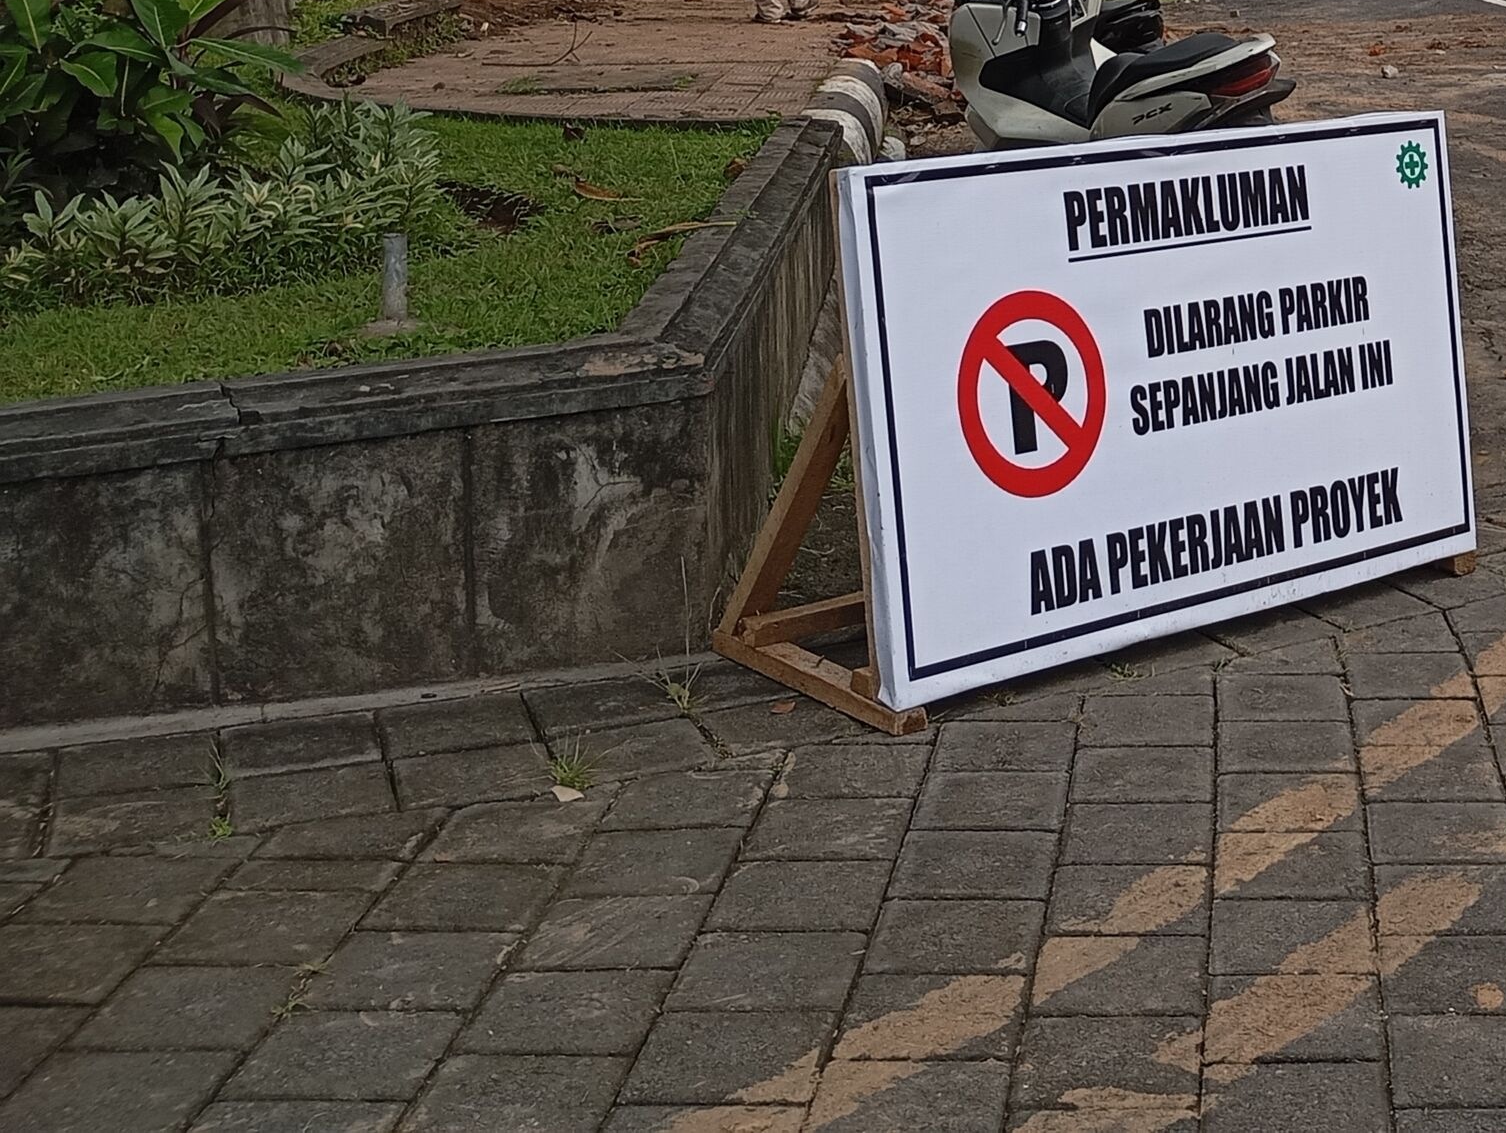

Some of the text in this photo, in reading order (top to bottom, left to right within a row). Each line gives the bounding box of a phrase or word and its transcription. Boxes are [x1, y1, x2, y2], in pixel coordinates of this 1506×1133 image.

[1132, 102, 1172, 126] PCX
[1064, 165, 1310, 251] PERMAKLUMAN
[1143, 276, 1370, 358] DILARANG PARKIR
[1130, 340, 1394, 436] SEPANJANG JALAN INI
[1030, 467, 1403, 615] ADA PEKERJAAN PROYEK
